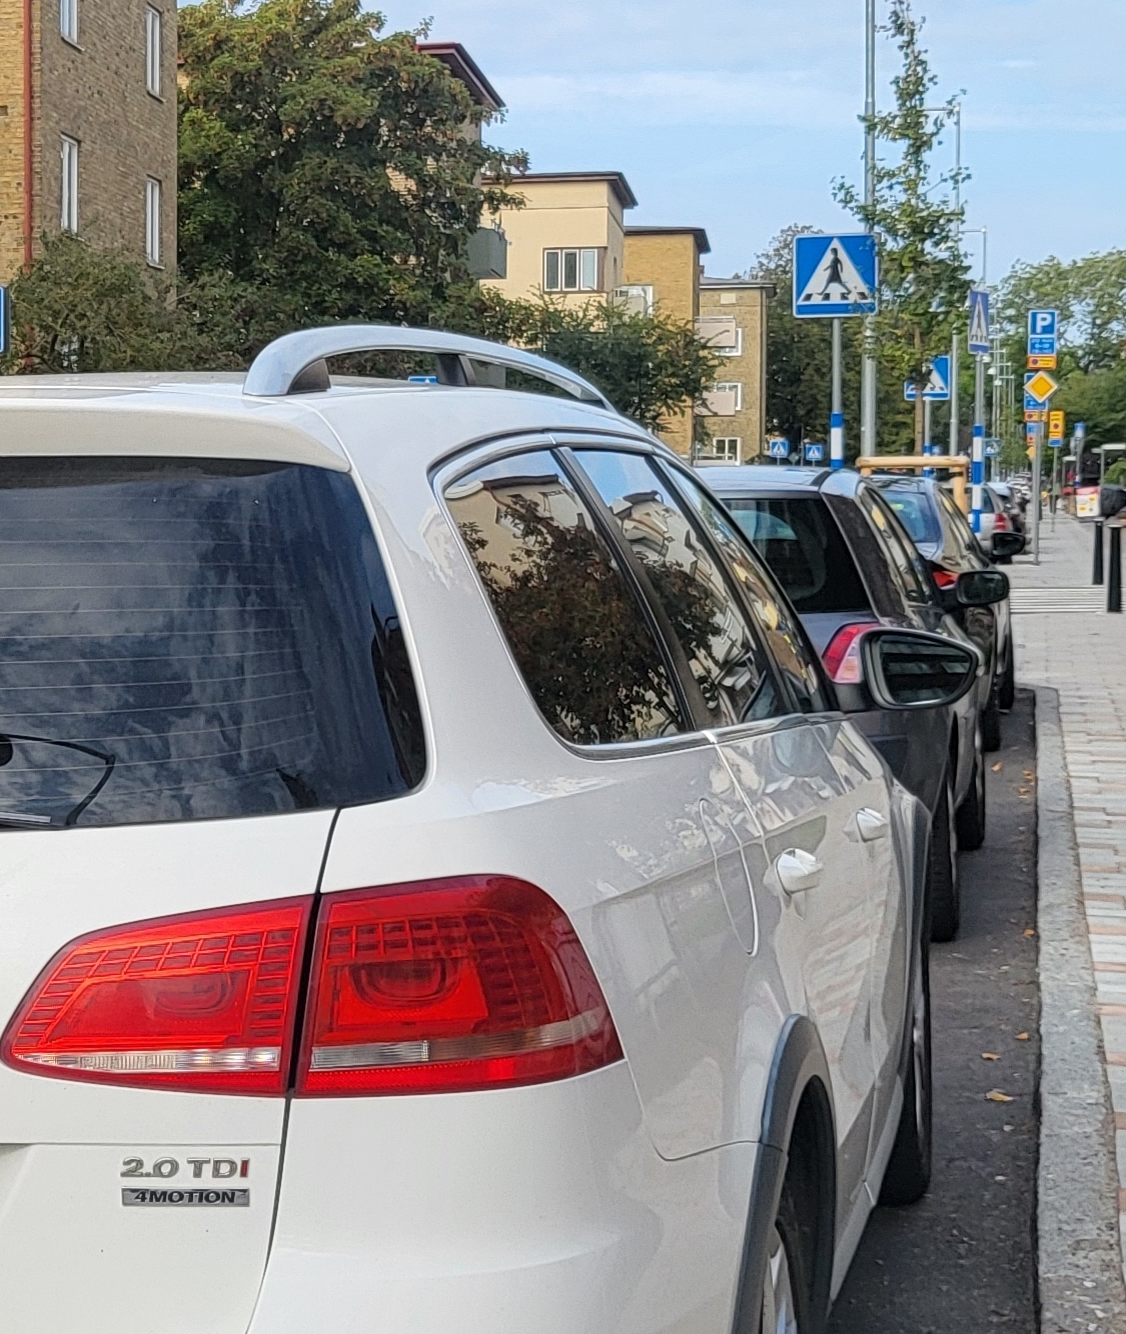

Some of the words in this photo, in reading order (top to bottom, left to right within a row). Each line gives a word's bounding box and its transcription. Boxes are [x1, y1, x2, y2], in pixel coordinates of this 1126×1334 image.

[1036, 313, 1052, 334] P
[120, 1157, 180, 1178] 2.0
[186, 1157, 251, 1178] TDI
[134, 1190, 236, 1204] 4MOTION
